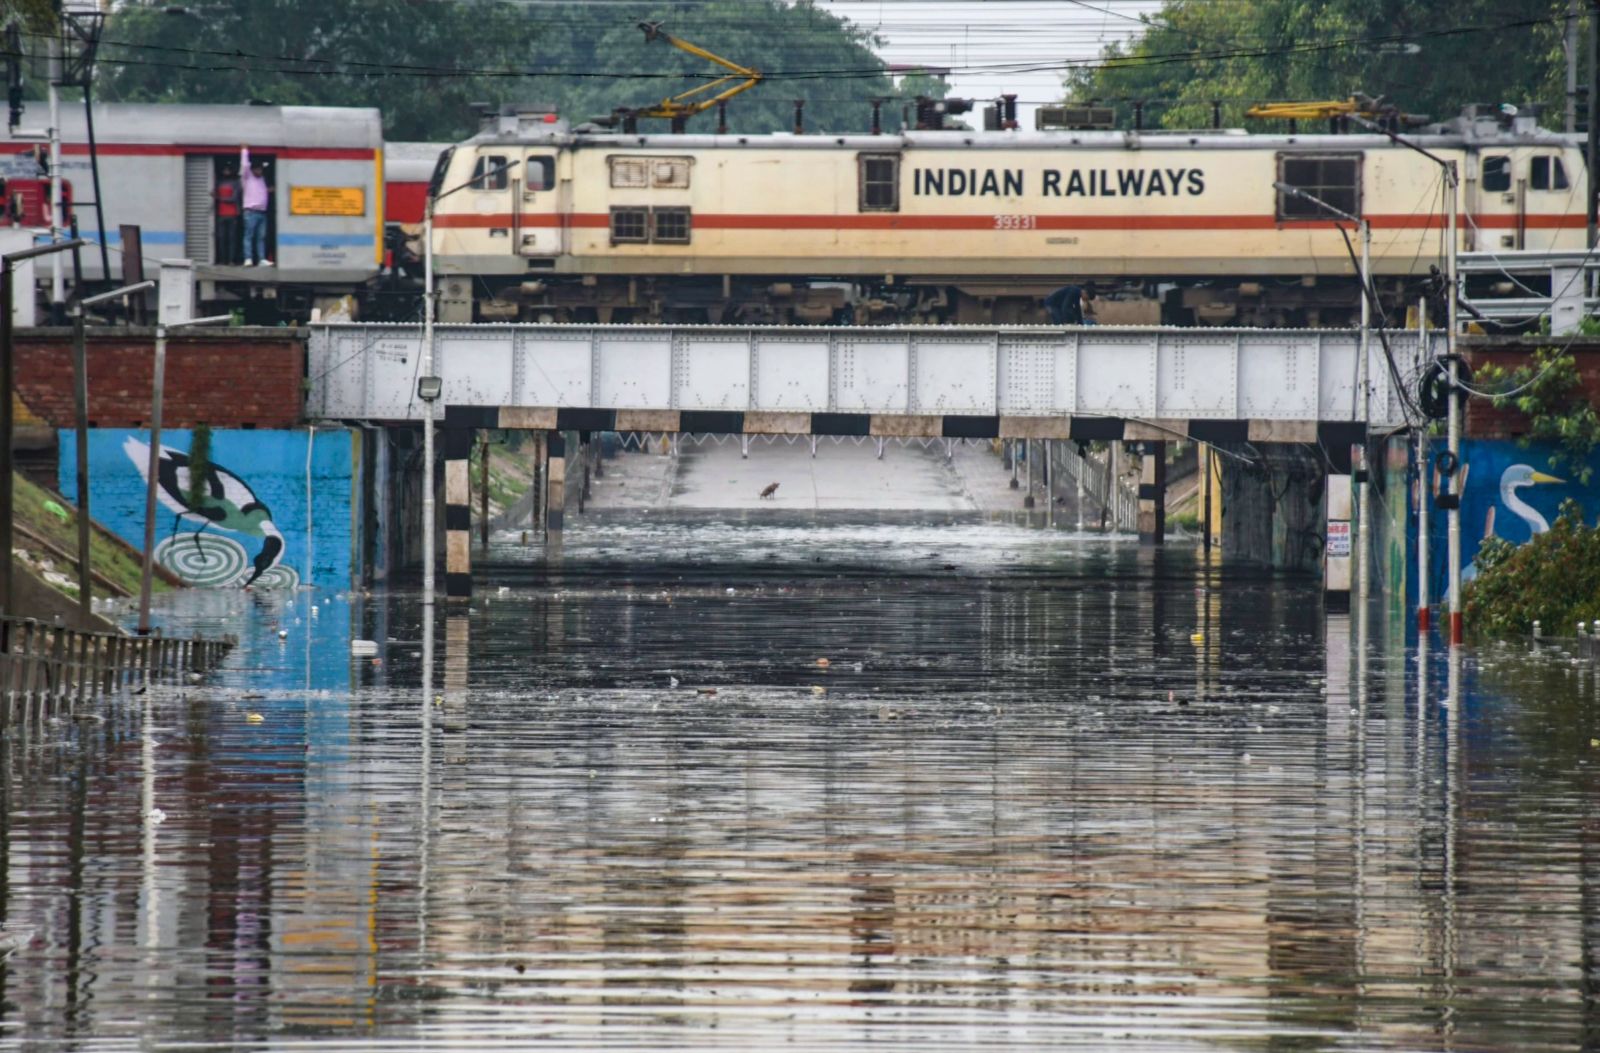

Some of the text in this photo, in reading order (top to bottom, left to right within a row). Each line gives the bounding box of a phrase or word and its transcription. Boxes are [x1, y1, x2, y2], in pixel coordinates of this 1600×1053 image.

[913, 168, 1205, 197] INDIAN RAILWAYS
[993, 215, 1037, 230] 39331
